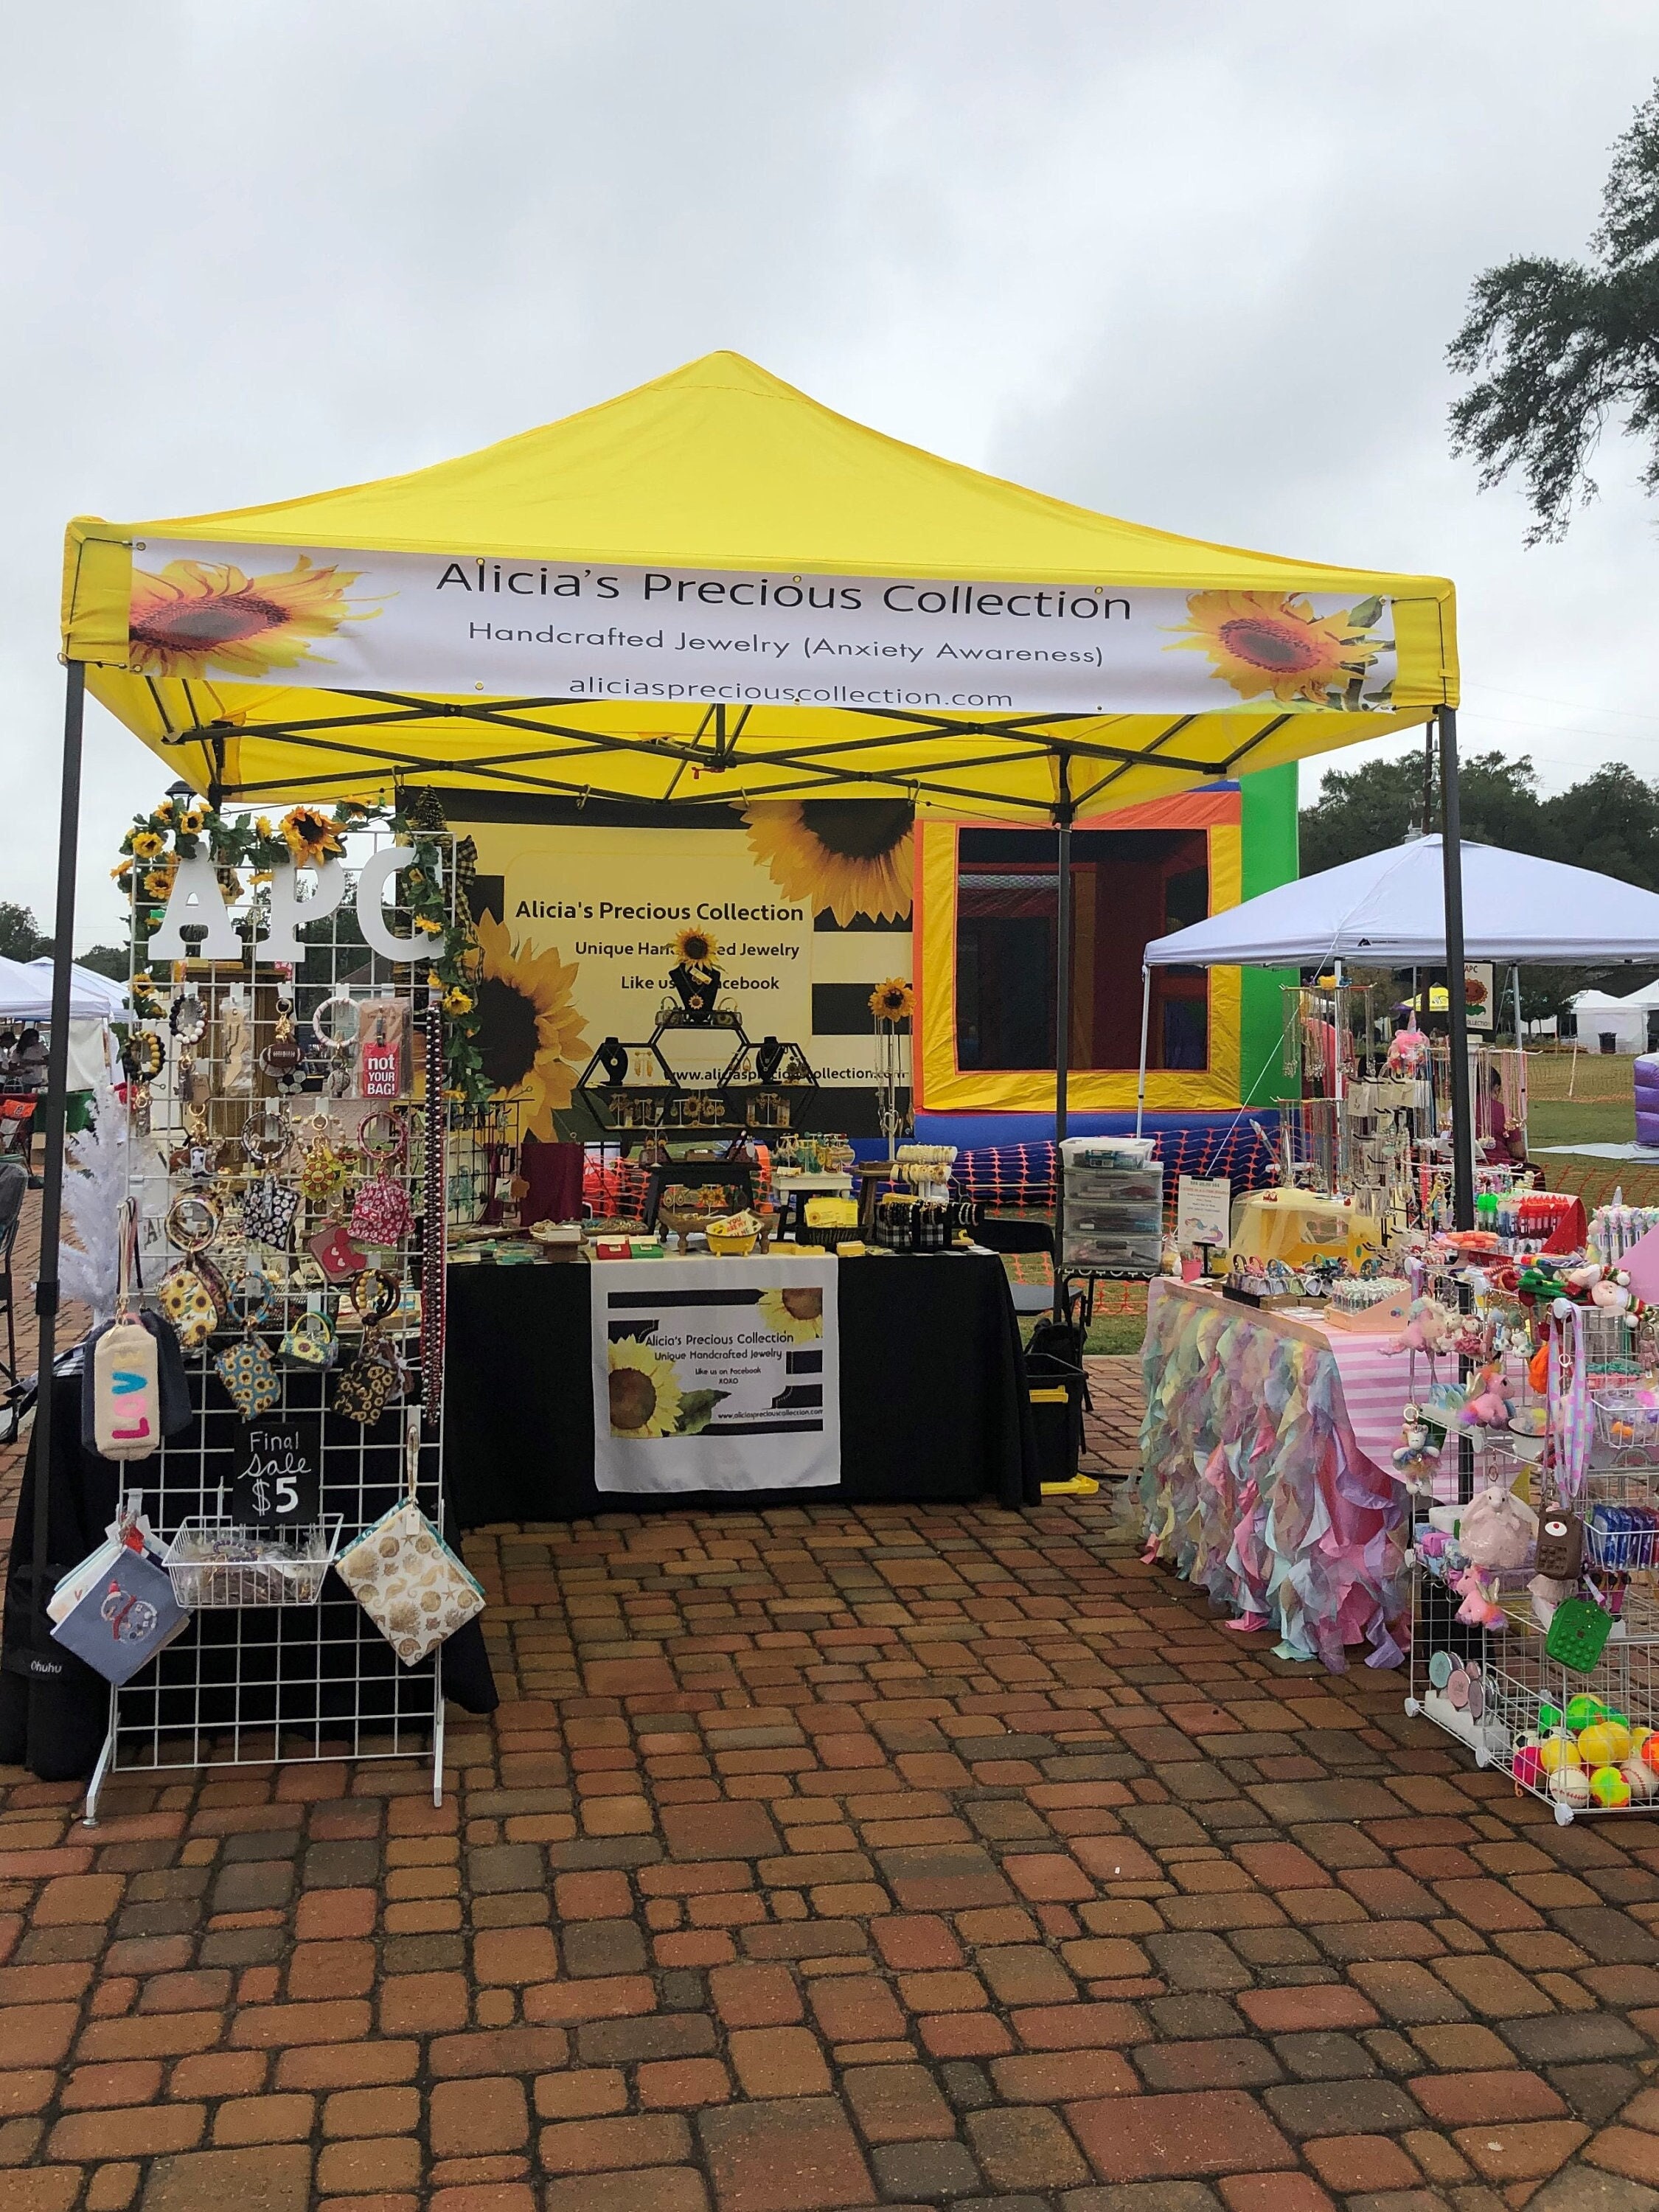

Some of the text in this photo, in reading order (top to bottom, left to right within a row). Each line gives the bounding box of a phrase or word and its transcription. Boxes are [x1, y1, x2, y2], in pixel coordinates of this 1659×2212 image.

[436, 562, 1131, 620] Alicia's Precious Collection
[469, 622, 1103, 667] Handcrafted Jewelry (Anxiety Awareness)
[569, 676, 1012, 707] aliciaspreciouscollection.com
[515, 900, 804, 921] Alicia's Precious Collection
[575, 941, 634, 959] Unique
[740, 943, 800, 960] Jewelry
[621, 975, 654, 990] Like
[658, 979, 676, 990] us
[367, 1054, 395, 1071] not
[369, 1071, 395, 1082] YOUR
[367, 1083, 395, 1096] BAG!
[645, 1331, 794, 1347] Alicia's Precious Collection
[654, 1348, 783, 1362] Unique Handcrafted Jewelry
[730, 1366, 762, 1375] Facebook
[250, 1430, 299, 1453] Final
[251, 1475, 299, 1517] $5
[30, 1660, 63, 1674] Ohuhu
